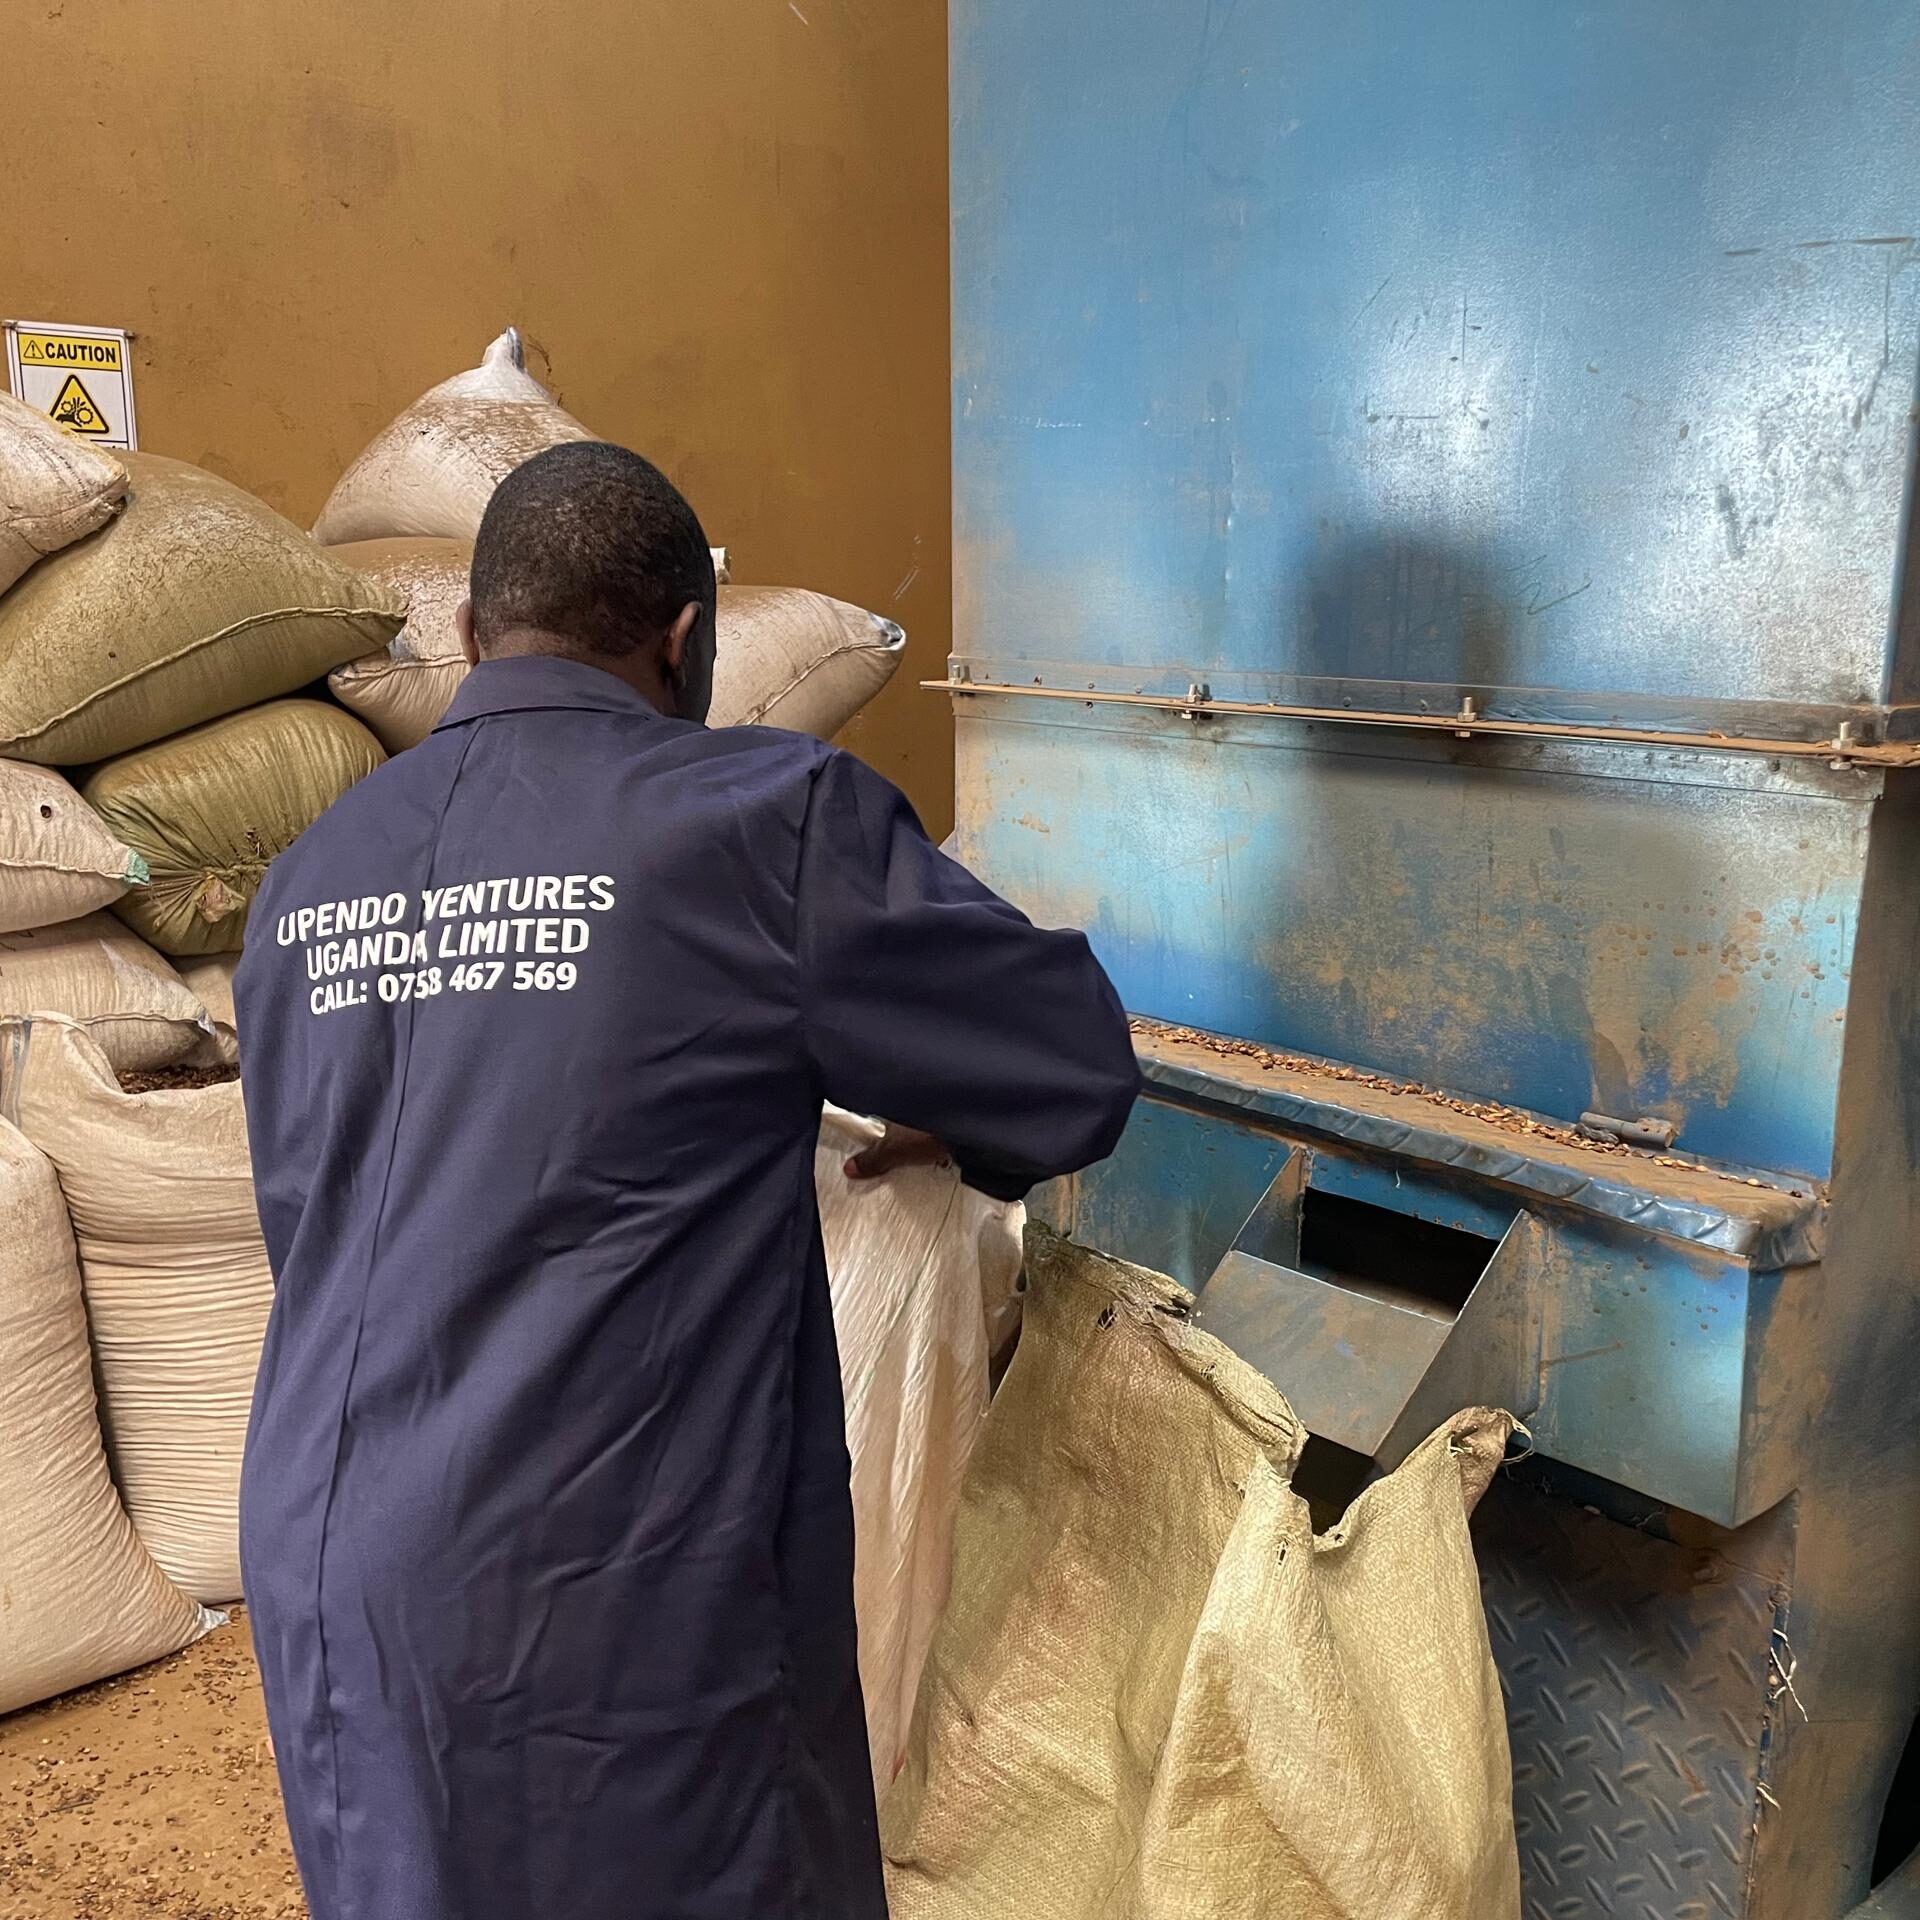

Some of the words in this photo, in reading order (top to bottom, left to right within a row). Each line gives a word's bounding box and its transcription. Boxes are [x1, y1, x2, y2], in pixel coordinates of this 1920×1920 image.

[45, 342, 117, 363] CAUTION
[276, 892, 407, 946] UPENDO
[421, 875, 615, 921] VENTURES
[306, 929, 428, 980] UGANDA
[438, 918, 590, 959] LIMITED
[310, 979, 368, 1015] CALL:
[378, 966, 442, 1002] 0758
[449, 961, 505, 992] 467
[513, 961, 577, 991] 569
